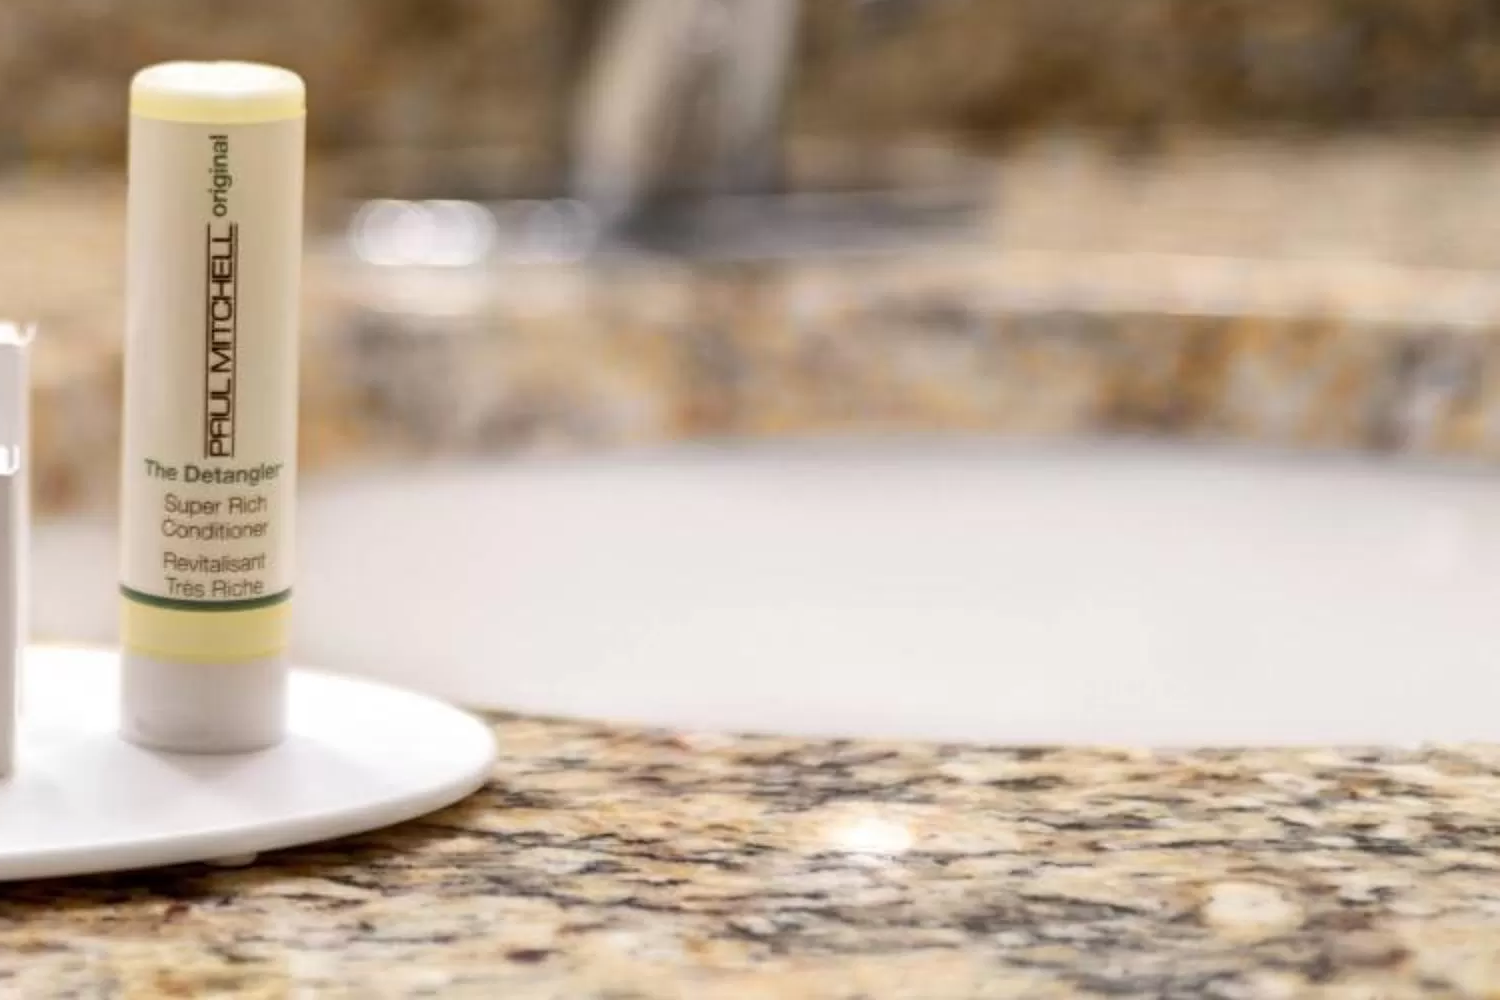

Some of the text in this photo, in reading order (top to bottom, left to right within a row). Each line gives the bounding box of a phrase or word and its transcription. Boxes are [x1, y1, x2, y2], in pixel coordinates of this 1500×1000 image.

[208, 133, 233, 217] original
[209, 223, 233, 457] PAUL MITCHELL
[145, 458, 283, 486] The Detangler
[164, 493, 267, 517] Super Rich
[161, 519, 269, 541] Conditioner
[163, 551, 267, 574] Revitalisant
[212, 578, 265, 597] Riche
